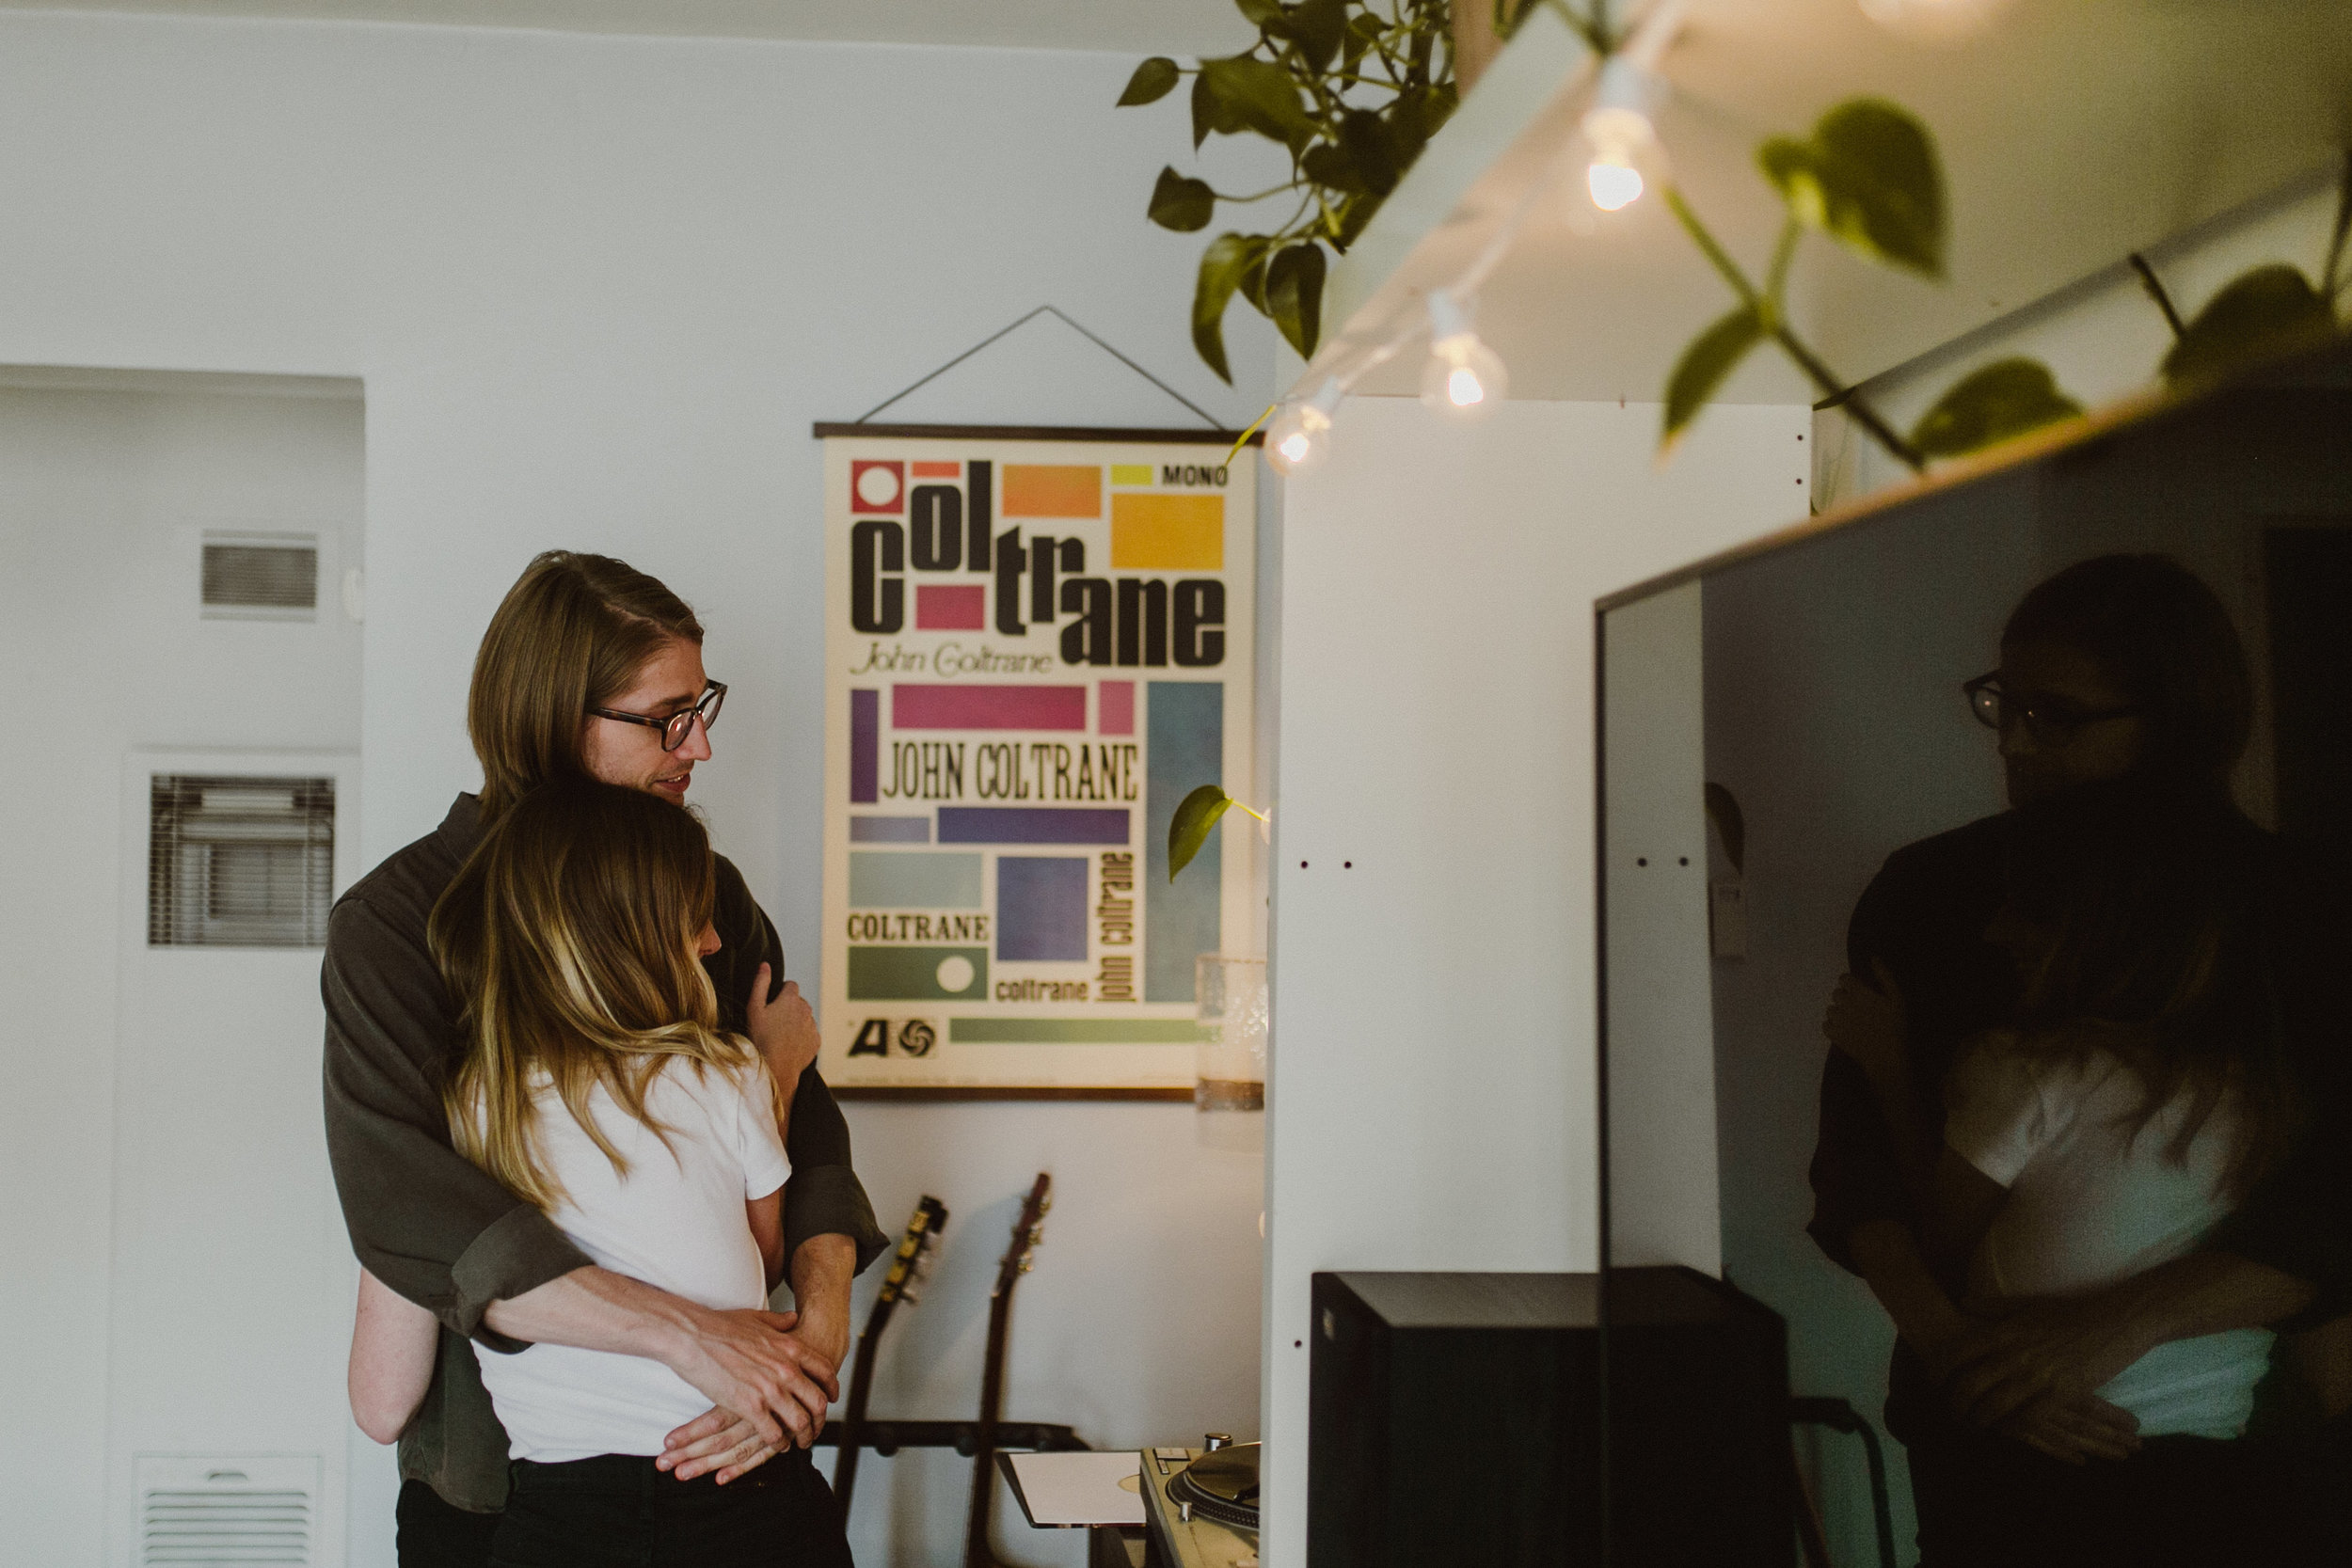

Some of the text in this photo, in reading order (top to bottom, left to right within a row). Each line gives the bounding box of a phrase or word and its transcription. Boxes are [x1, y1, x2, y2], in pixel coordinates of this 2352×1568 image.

[1163, 465, 1228, 487] MONO
[850, 641, 1053, 677] John Coltrane
[882, 742, 1137, 800] JOHN COLTRANE
[1097, 851, 1134, 944] coltrane
[848, 914, 989, 941] COLTRANE
[996, 979, 1088, 1003] coltrane
